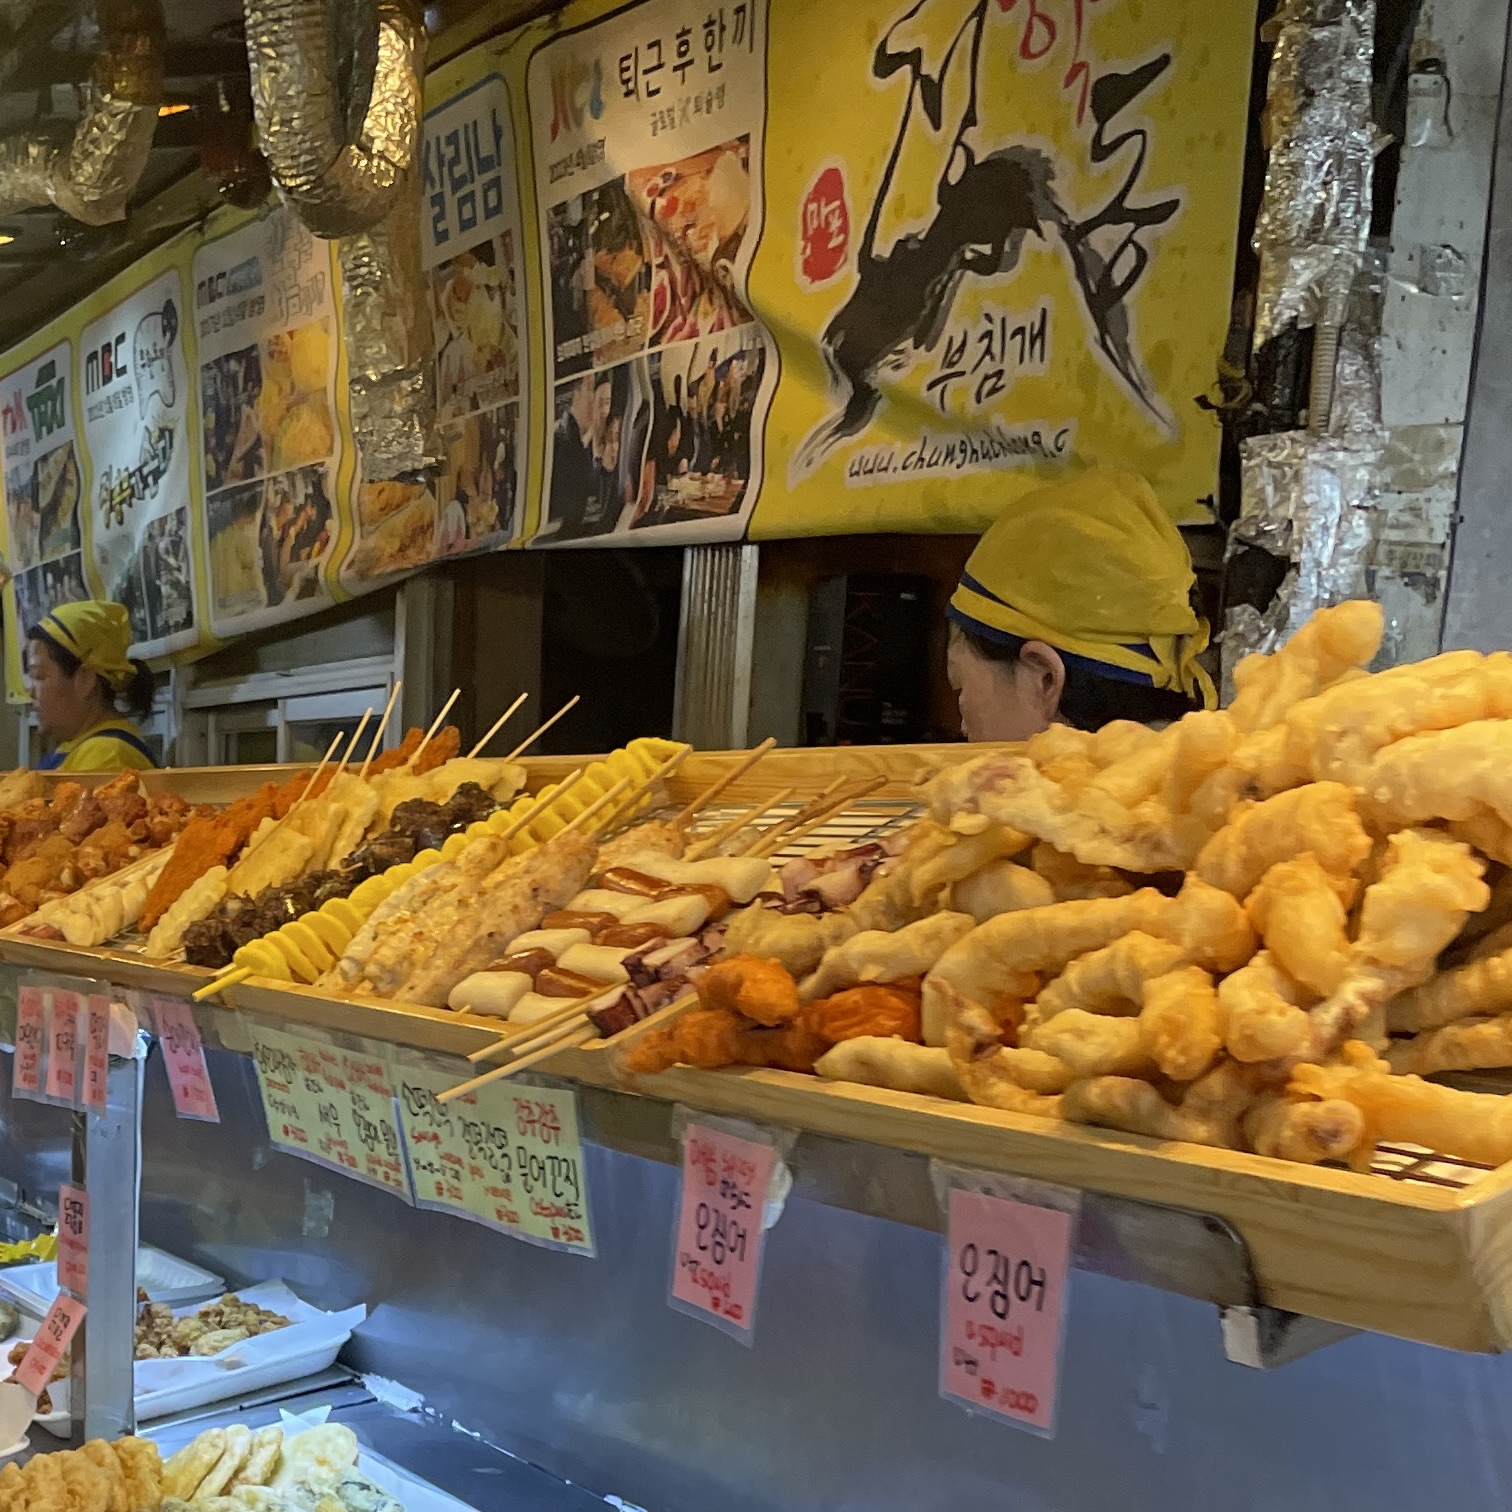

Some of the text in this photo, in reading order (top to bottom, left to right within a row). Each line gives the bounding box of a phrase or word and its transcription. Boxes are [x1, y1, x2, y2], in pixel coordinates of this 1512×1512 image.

[86, 331, 127, 396] MBC
[926, 307, 1048, 413] 부침개
[696, 1202, 748, 1265] 오징어
[960, 1243, 1046, 1320] 오징어
